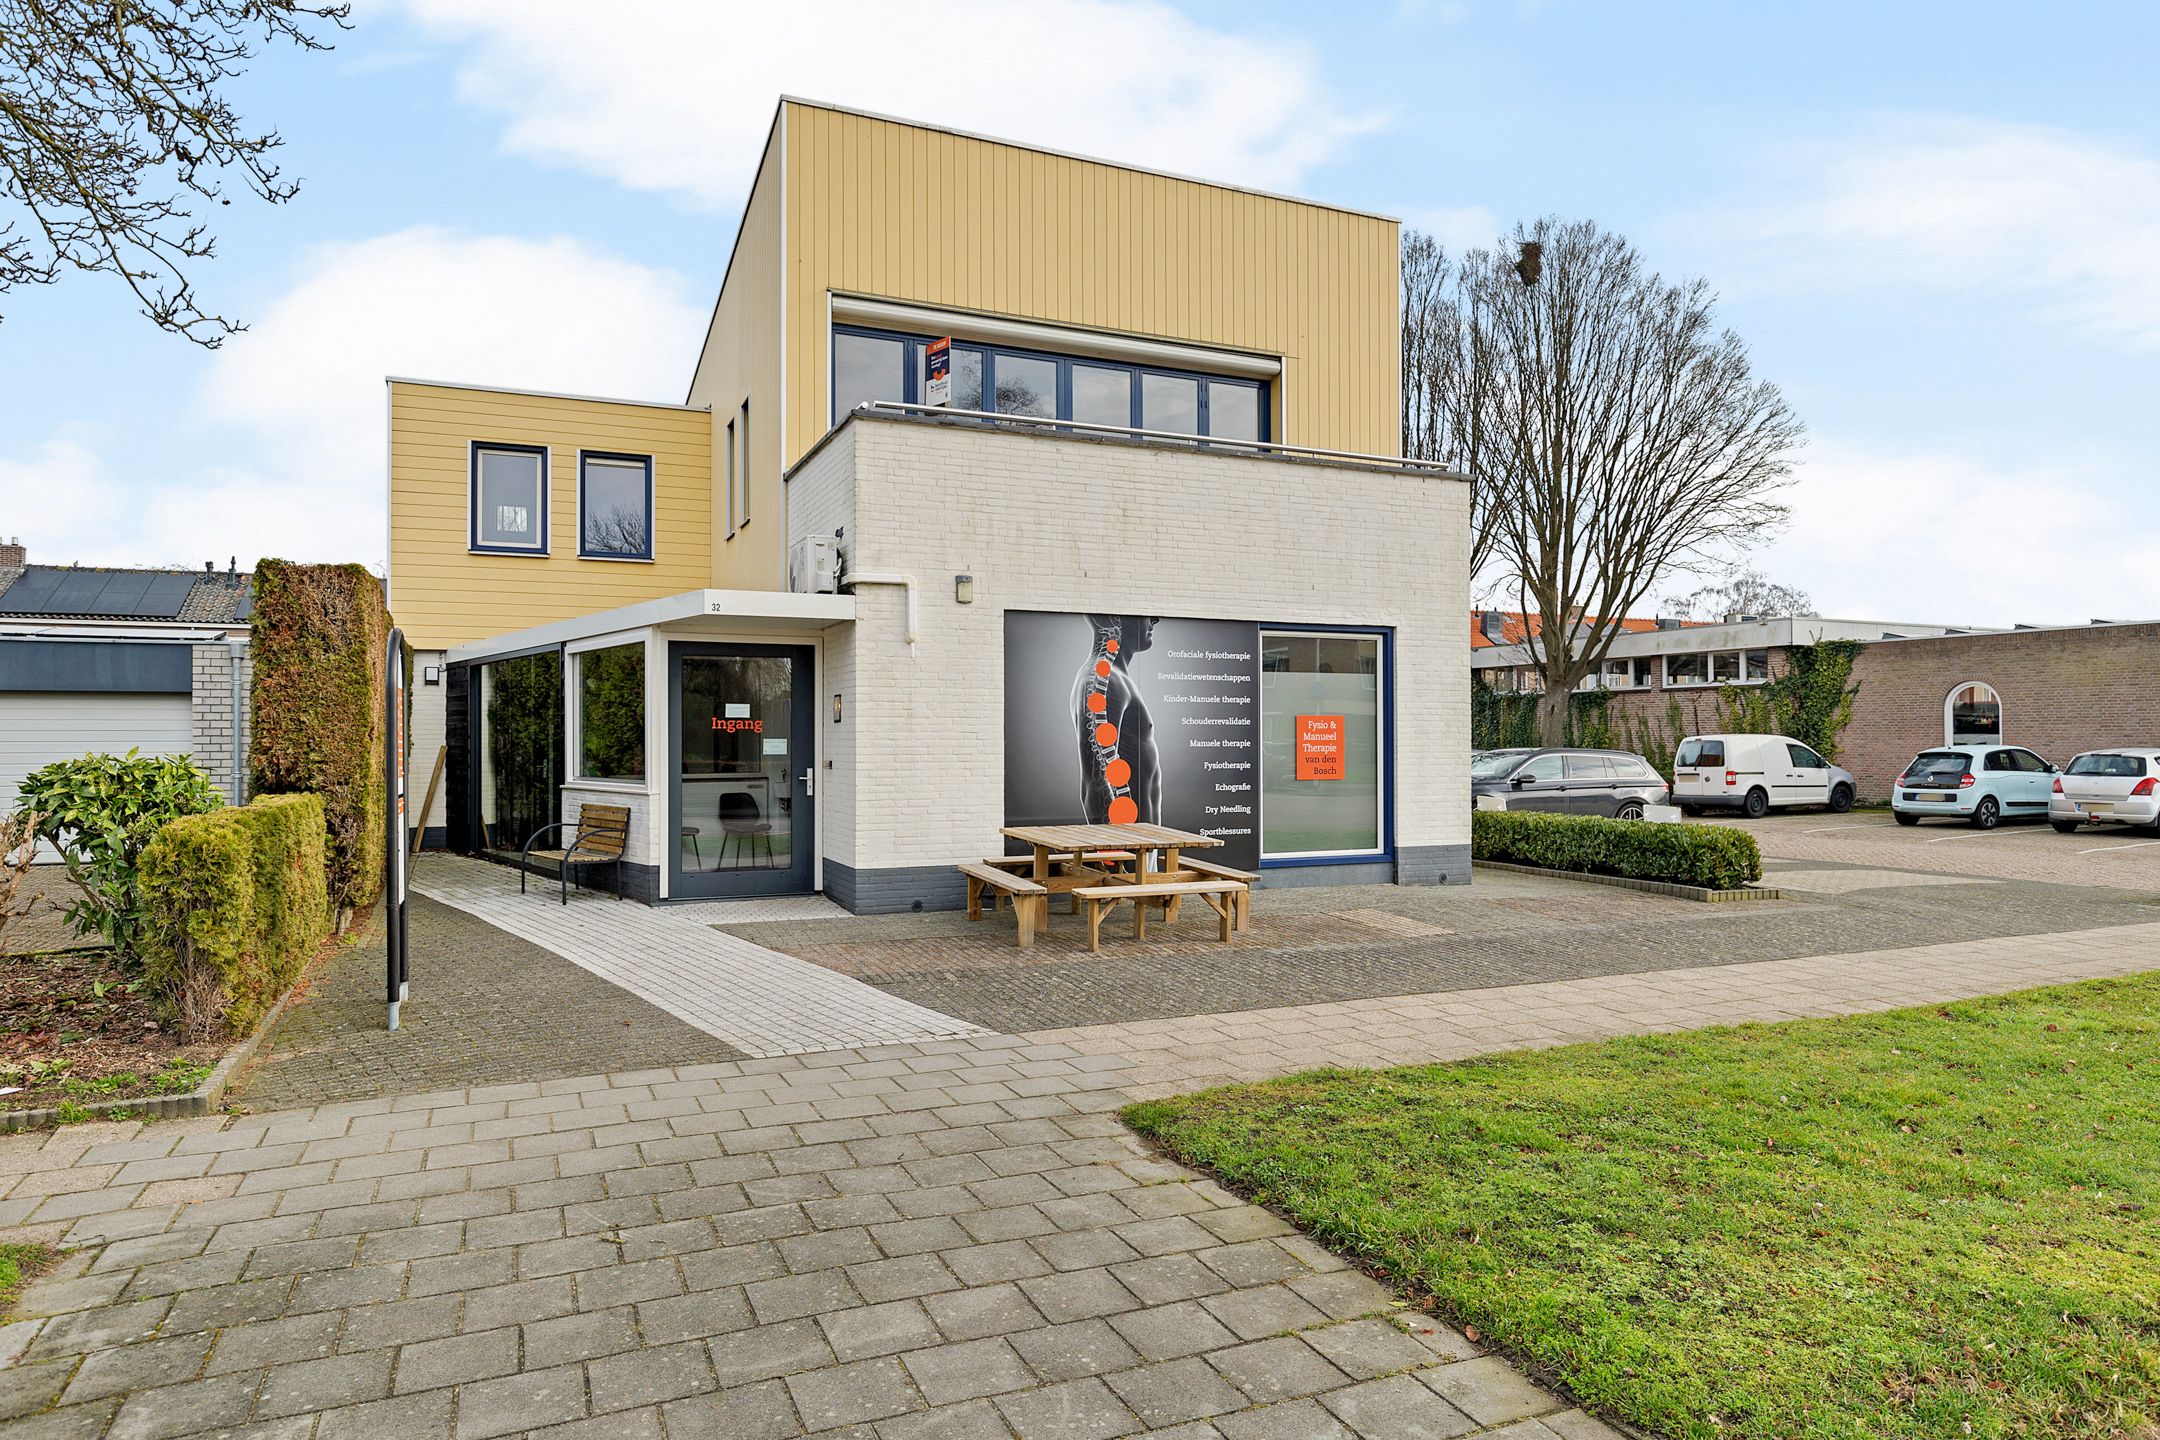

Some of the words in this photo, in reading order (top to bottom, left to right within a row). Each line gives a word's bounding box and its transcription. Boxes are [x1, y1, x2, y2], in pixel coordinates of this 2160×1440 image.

[711, 603, 721, 611] 32
[1167, 650, 1204, 658] Orofaciale
[1205, 651, 1251, 661] fysiotherapie
[1157, 672, 1251, 683] Revalidatiewetenschappen
[1163, 695, 1220, 703] Kinder-Manuele
[1222, 696, 1251, 705] therapie
[711, 717, 763, 733] Ingang
[1181, 717, 1251, 725] Schouderrevalidatie
[1308, 720, 1328, 731] Fysio
[1330, 721, 1337, 729] &
[1303, 732, 1337, 741] Manueel
[1189, 739, 1221, 747] Manuele
[1222, 739, 1251, 749] therapie
[1303, 743, 1337, 754] Therapie
[1321, 755, 1337, 763] den
[1204, 761, 1251, 771] Fysiotherapie
[1313, 766, 1337, 775] Bosch
[1215, 783, 1251, 792] Echografie
[1205, 806, 1219, 815] Dry
[1220, 805, 1251, 814] Needling
[1200, 827, 1251, 837] Sportblessures
